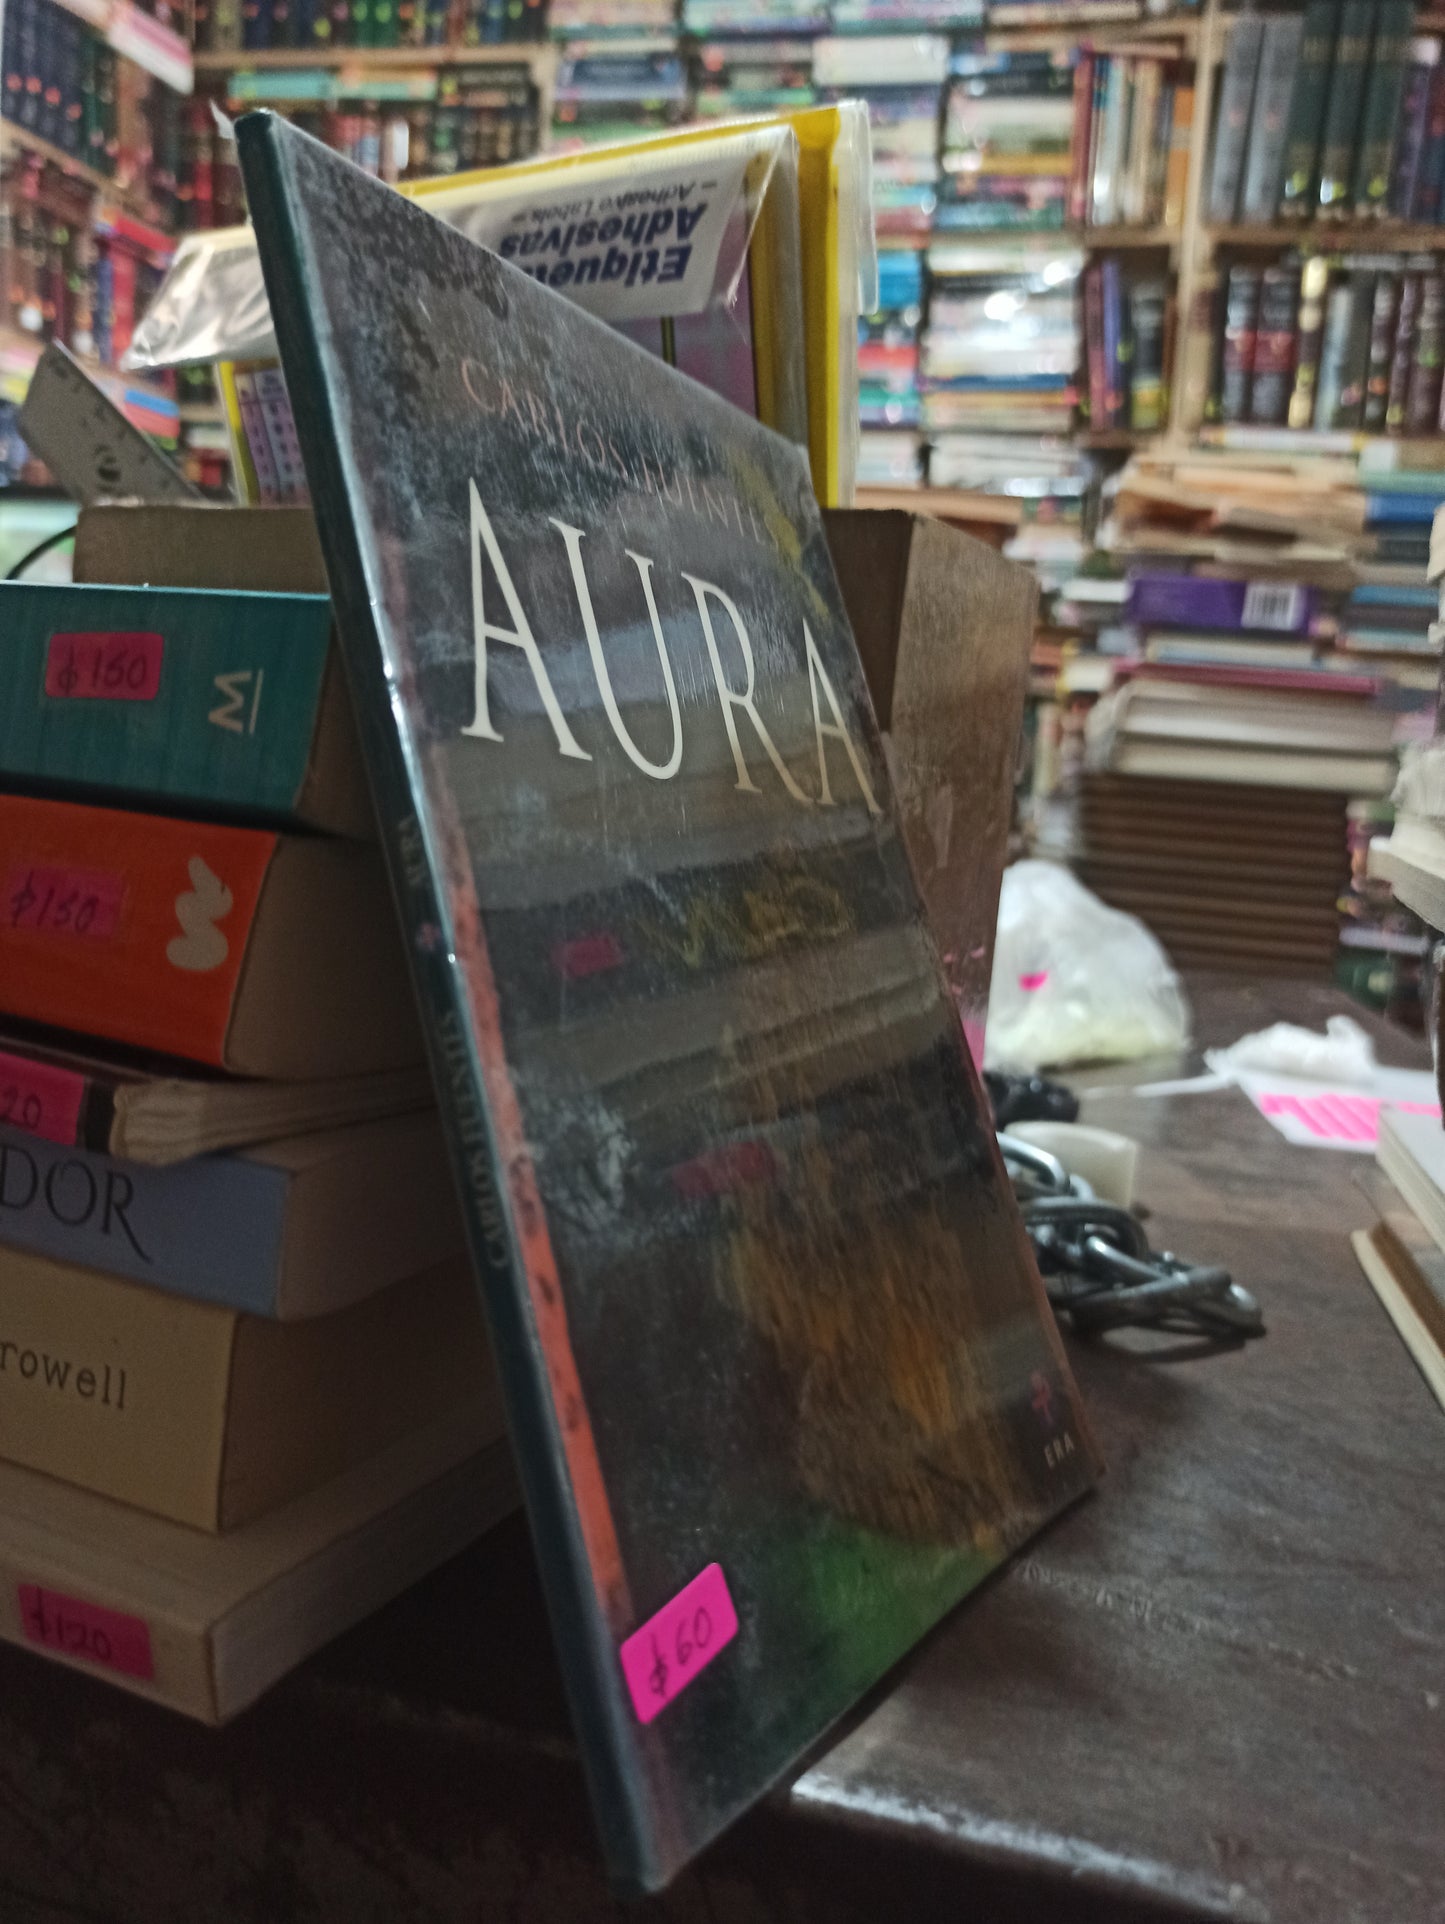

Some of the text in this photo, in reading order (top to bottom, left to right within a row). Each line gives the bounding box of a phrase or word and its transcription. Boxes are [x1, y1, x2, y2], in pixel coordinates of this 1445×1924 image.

[500, 203, 709, 258] Adhesivas
[461, 357, 629, 483] CARLOS
[460, 477, 882, 815] AURA
[0, 1145, 154, 1266] DOR
[1044, 1431, 1075, 1468] ERA
